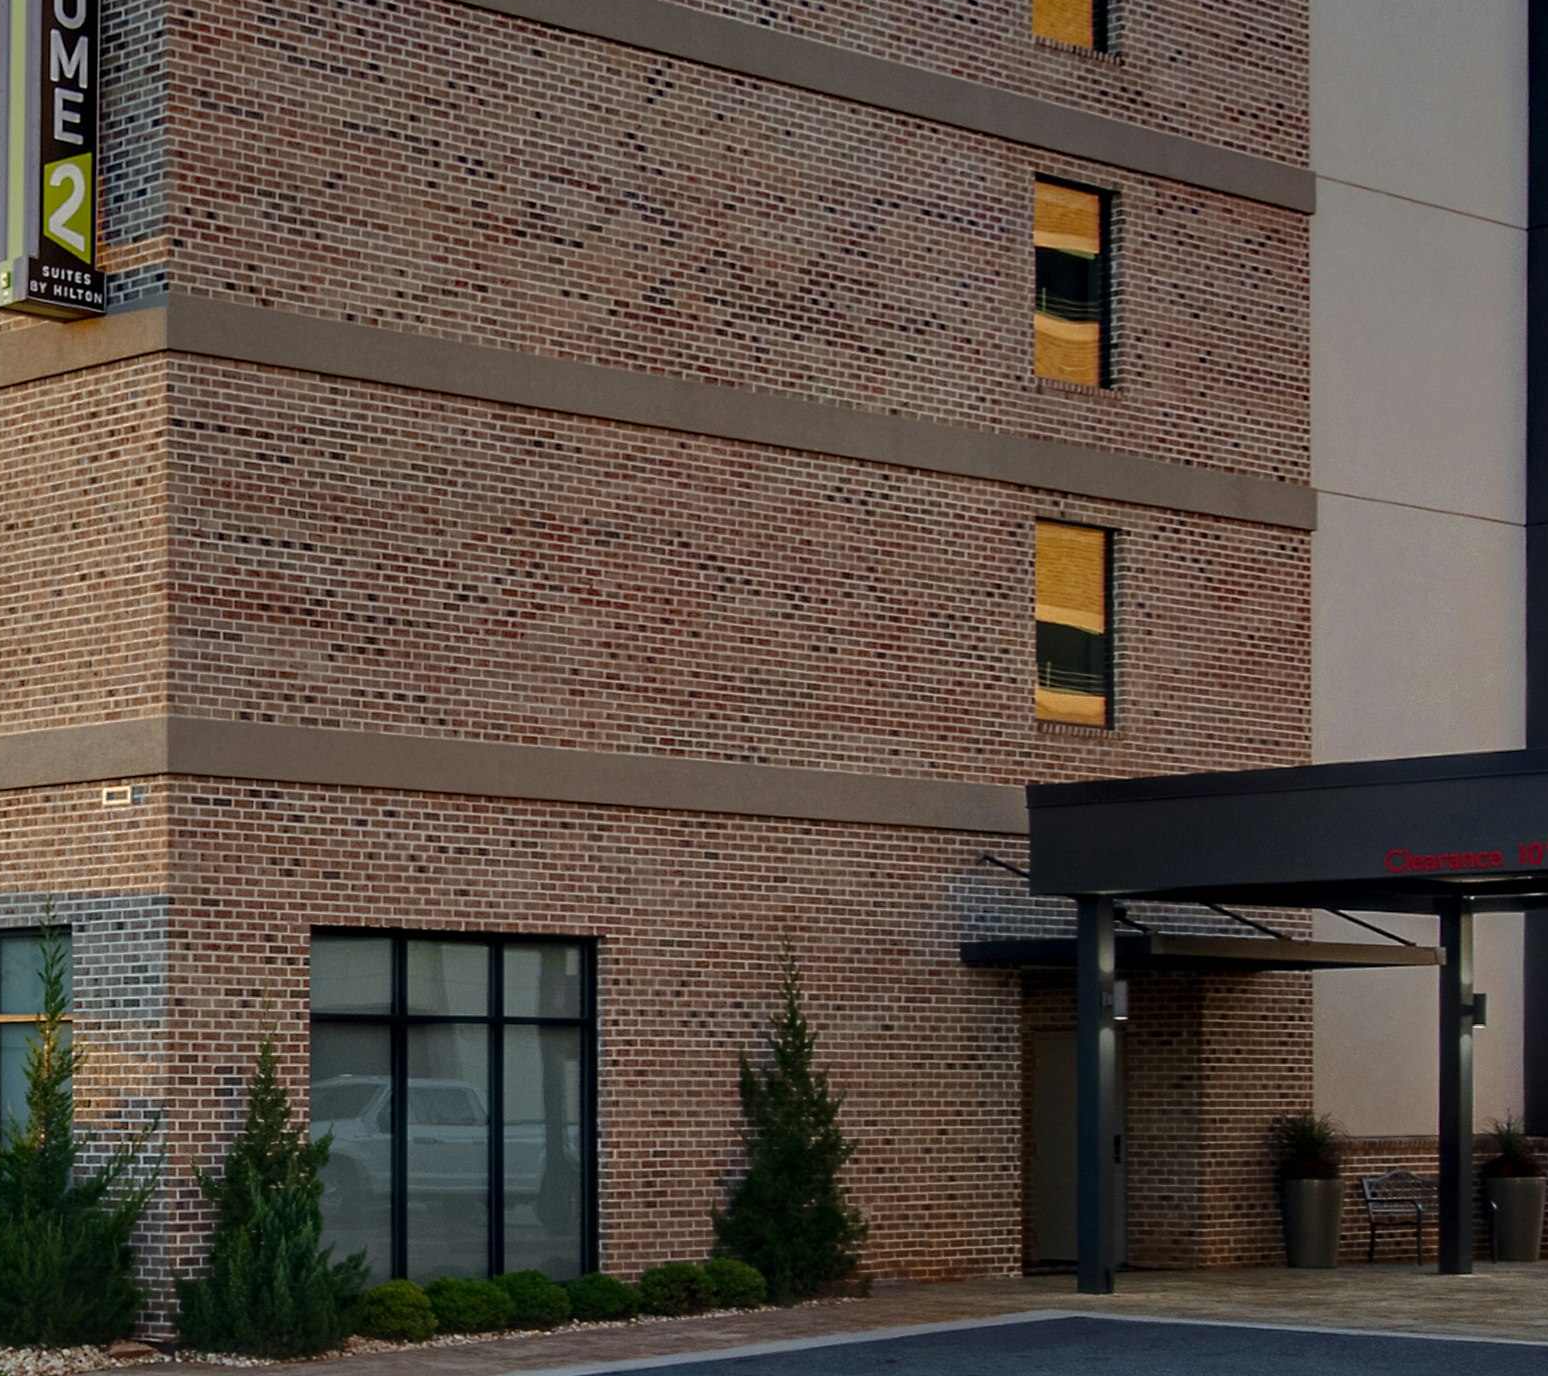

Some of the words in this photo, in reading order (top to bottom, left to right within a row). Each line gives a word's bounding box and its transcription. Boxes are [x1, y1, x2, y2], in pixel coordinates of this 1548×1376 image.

[42, 266, 92, 285] SUITES
[30, 280, 47, 293] BY
[53, 285, 103, 304] HILTON
[1384, 849, 1503, 873] Clearance
